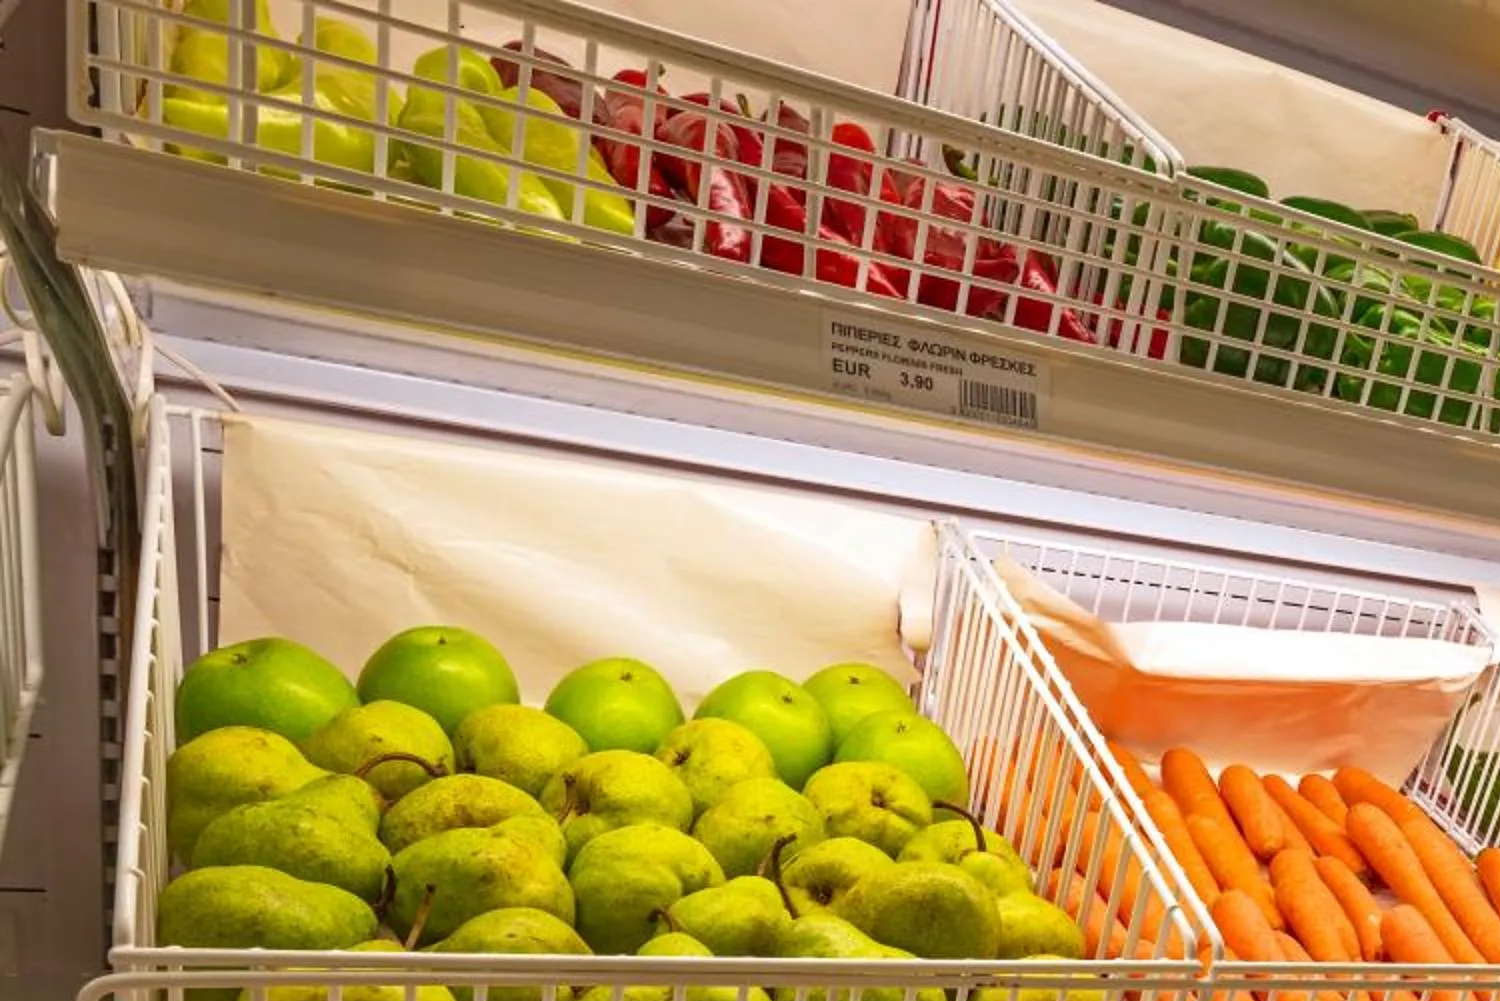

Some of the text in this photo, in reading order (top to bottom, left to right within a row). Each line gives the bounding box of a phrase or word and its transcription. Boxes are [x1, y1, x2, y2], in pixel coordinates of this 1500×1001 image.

[831, 321, 1037, 377] ΠΙΠΕΡΙΕΣ ΦΛΩΡΙΝ ΦΡΕΣΚΕΣ
[832, 358, 872, 379] EUR
